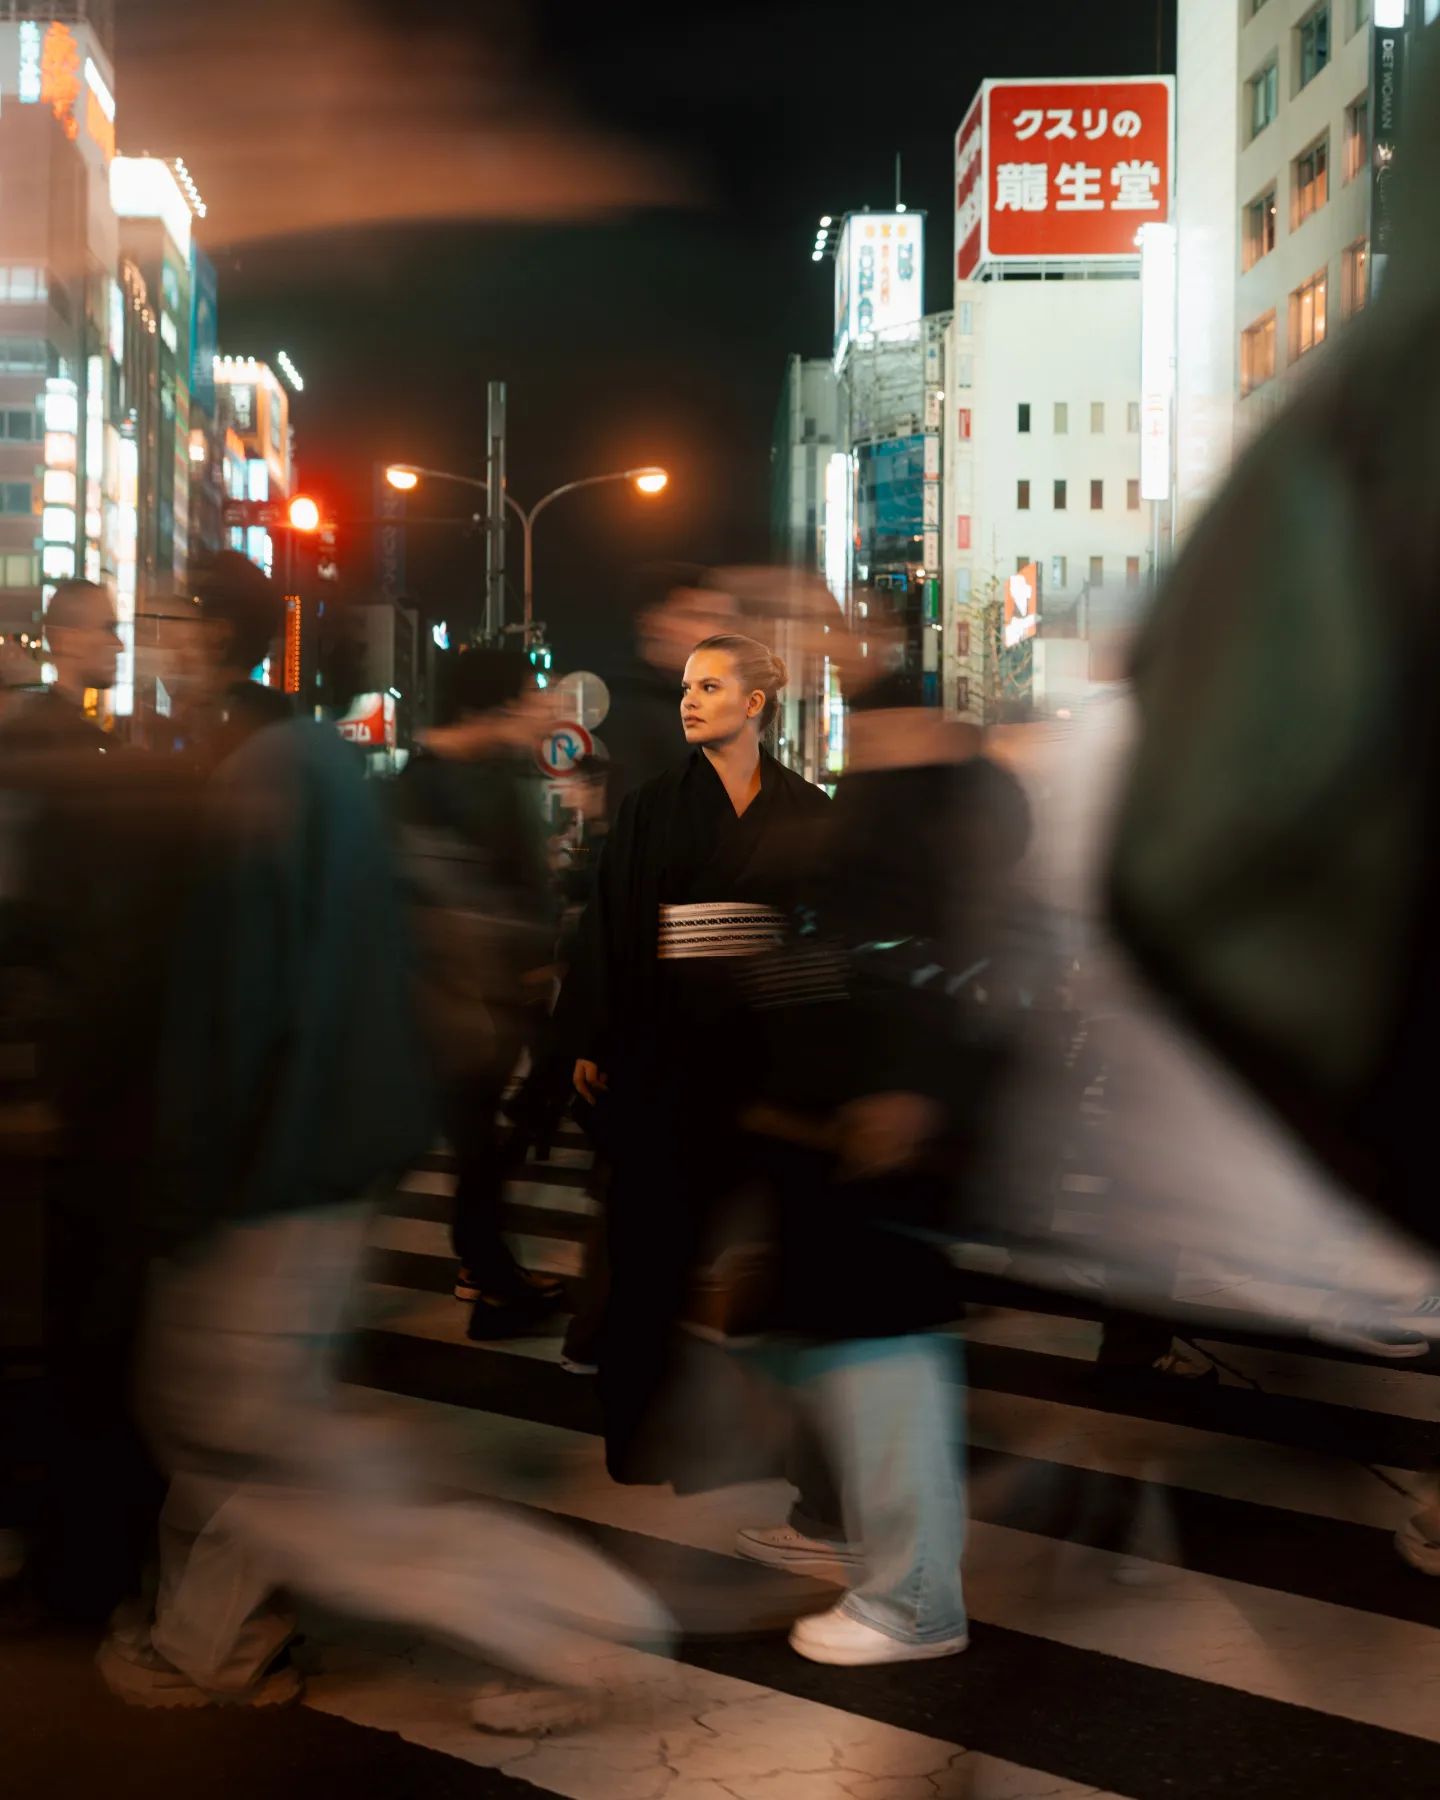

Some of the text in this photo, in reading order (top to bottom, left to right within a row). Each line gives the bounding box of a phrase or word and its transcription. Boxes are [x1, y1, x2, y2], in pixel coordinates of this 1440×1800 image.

[1381, 38, 1395, 69] DIET
[1012, 108, 1143, 141] クスリの
[993, 159, 1161, 212] 龍生堂
